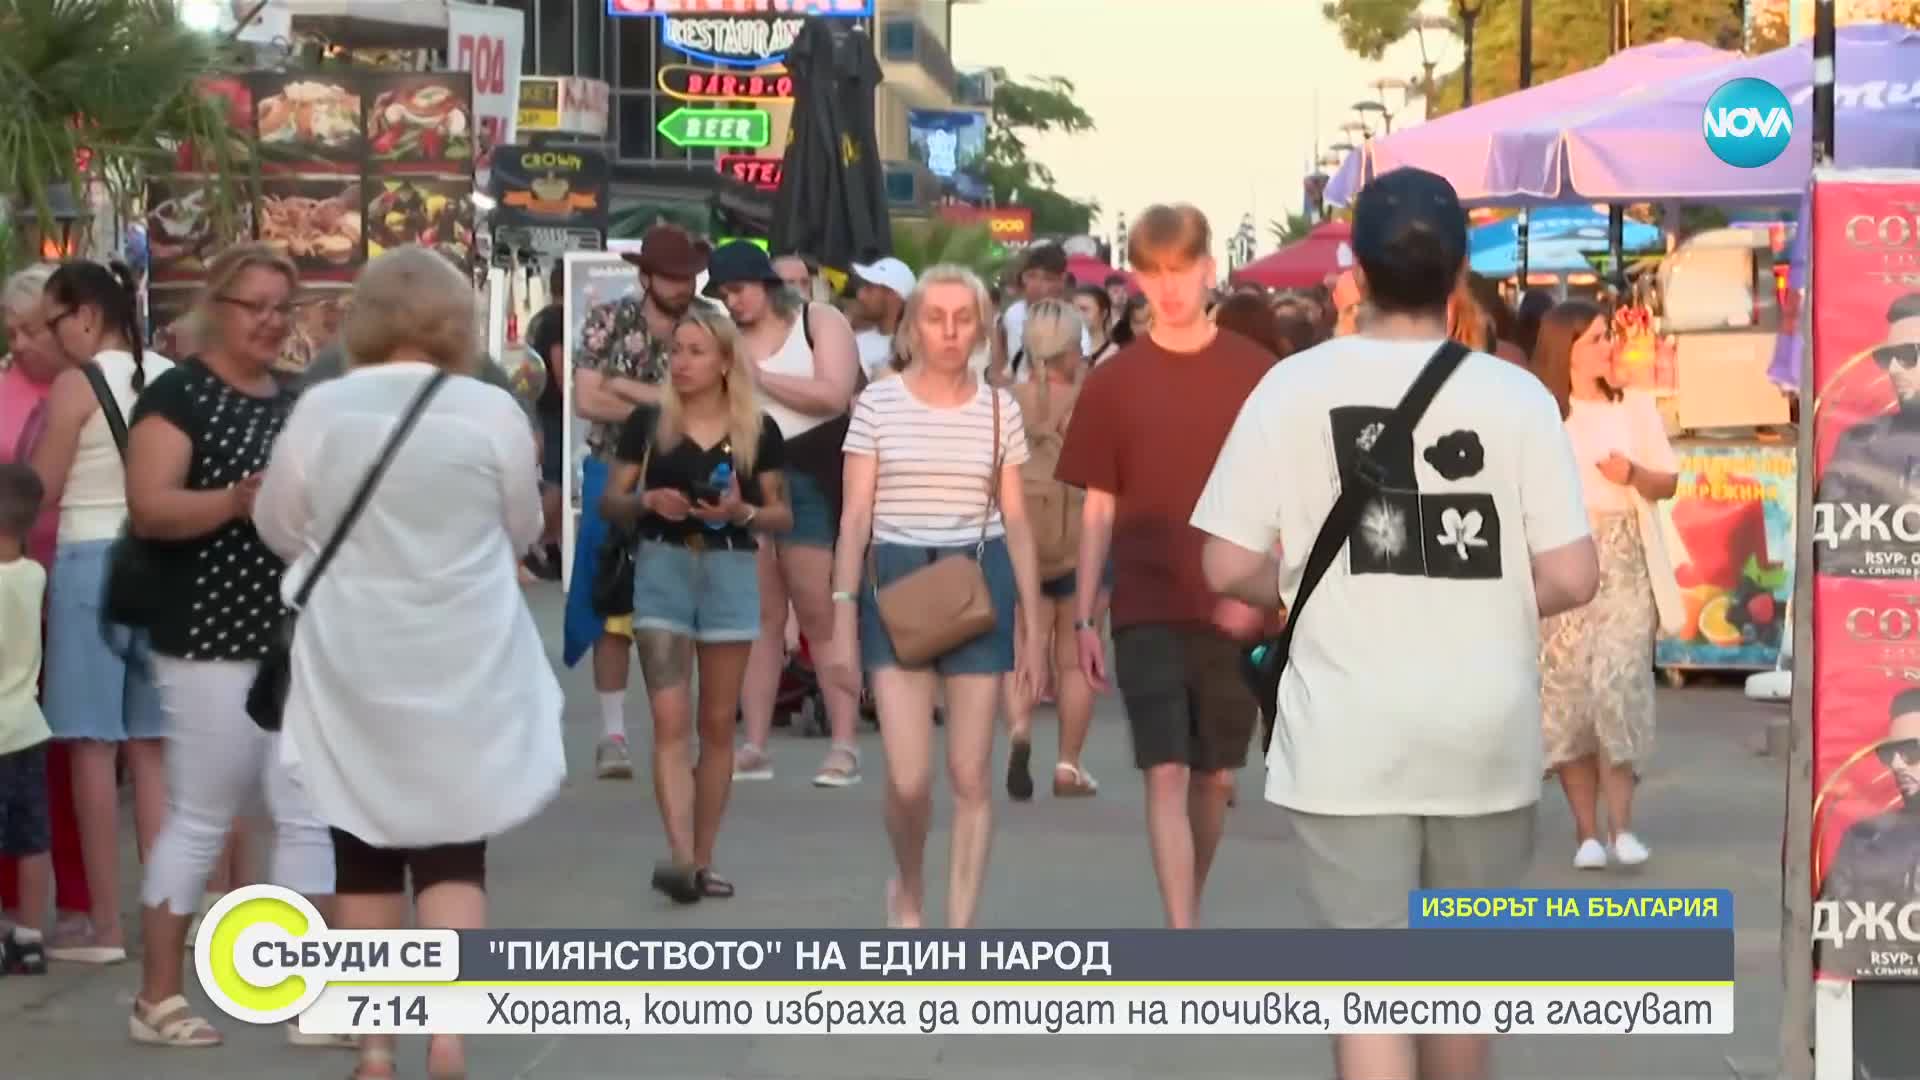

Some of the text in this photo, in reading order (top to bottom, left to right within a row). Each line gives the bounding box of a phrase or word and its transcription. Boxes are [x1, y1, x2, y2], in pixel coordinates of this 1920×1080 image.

[667, 17, 806, 57] RESTAURAN
[686, 117, 751, 142] BEER
[520, 151, 583, 171] CROWN
[1845, 215, 1920, 248] CO
[1864, 551, 1908, 565] RSVP:
[1845, 607, 1920, 641] CO
[1870, 951, 1914, 966] RSVP:
